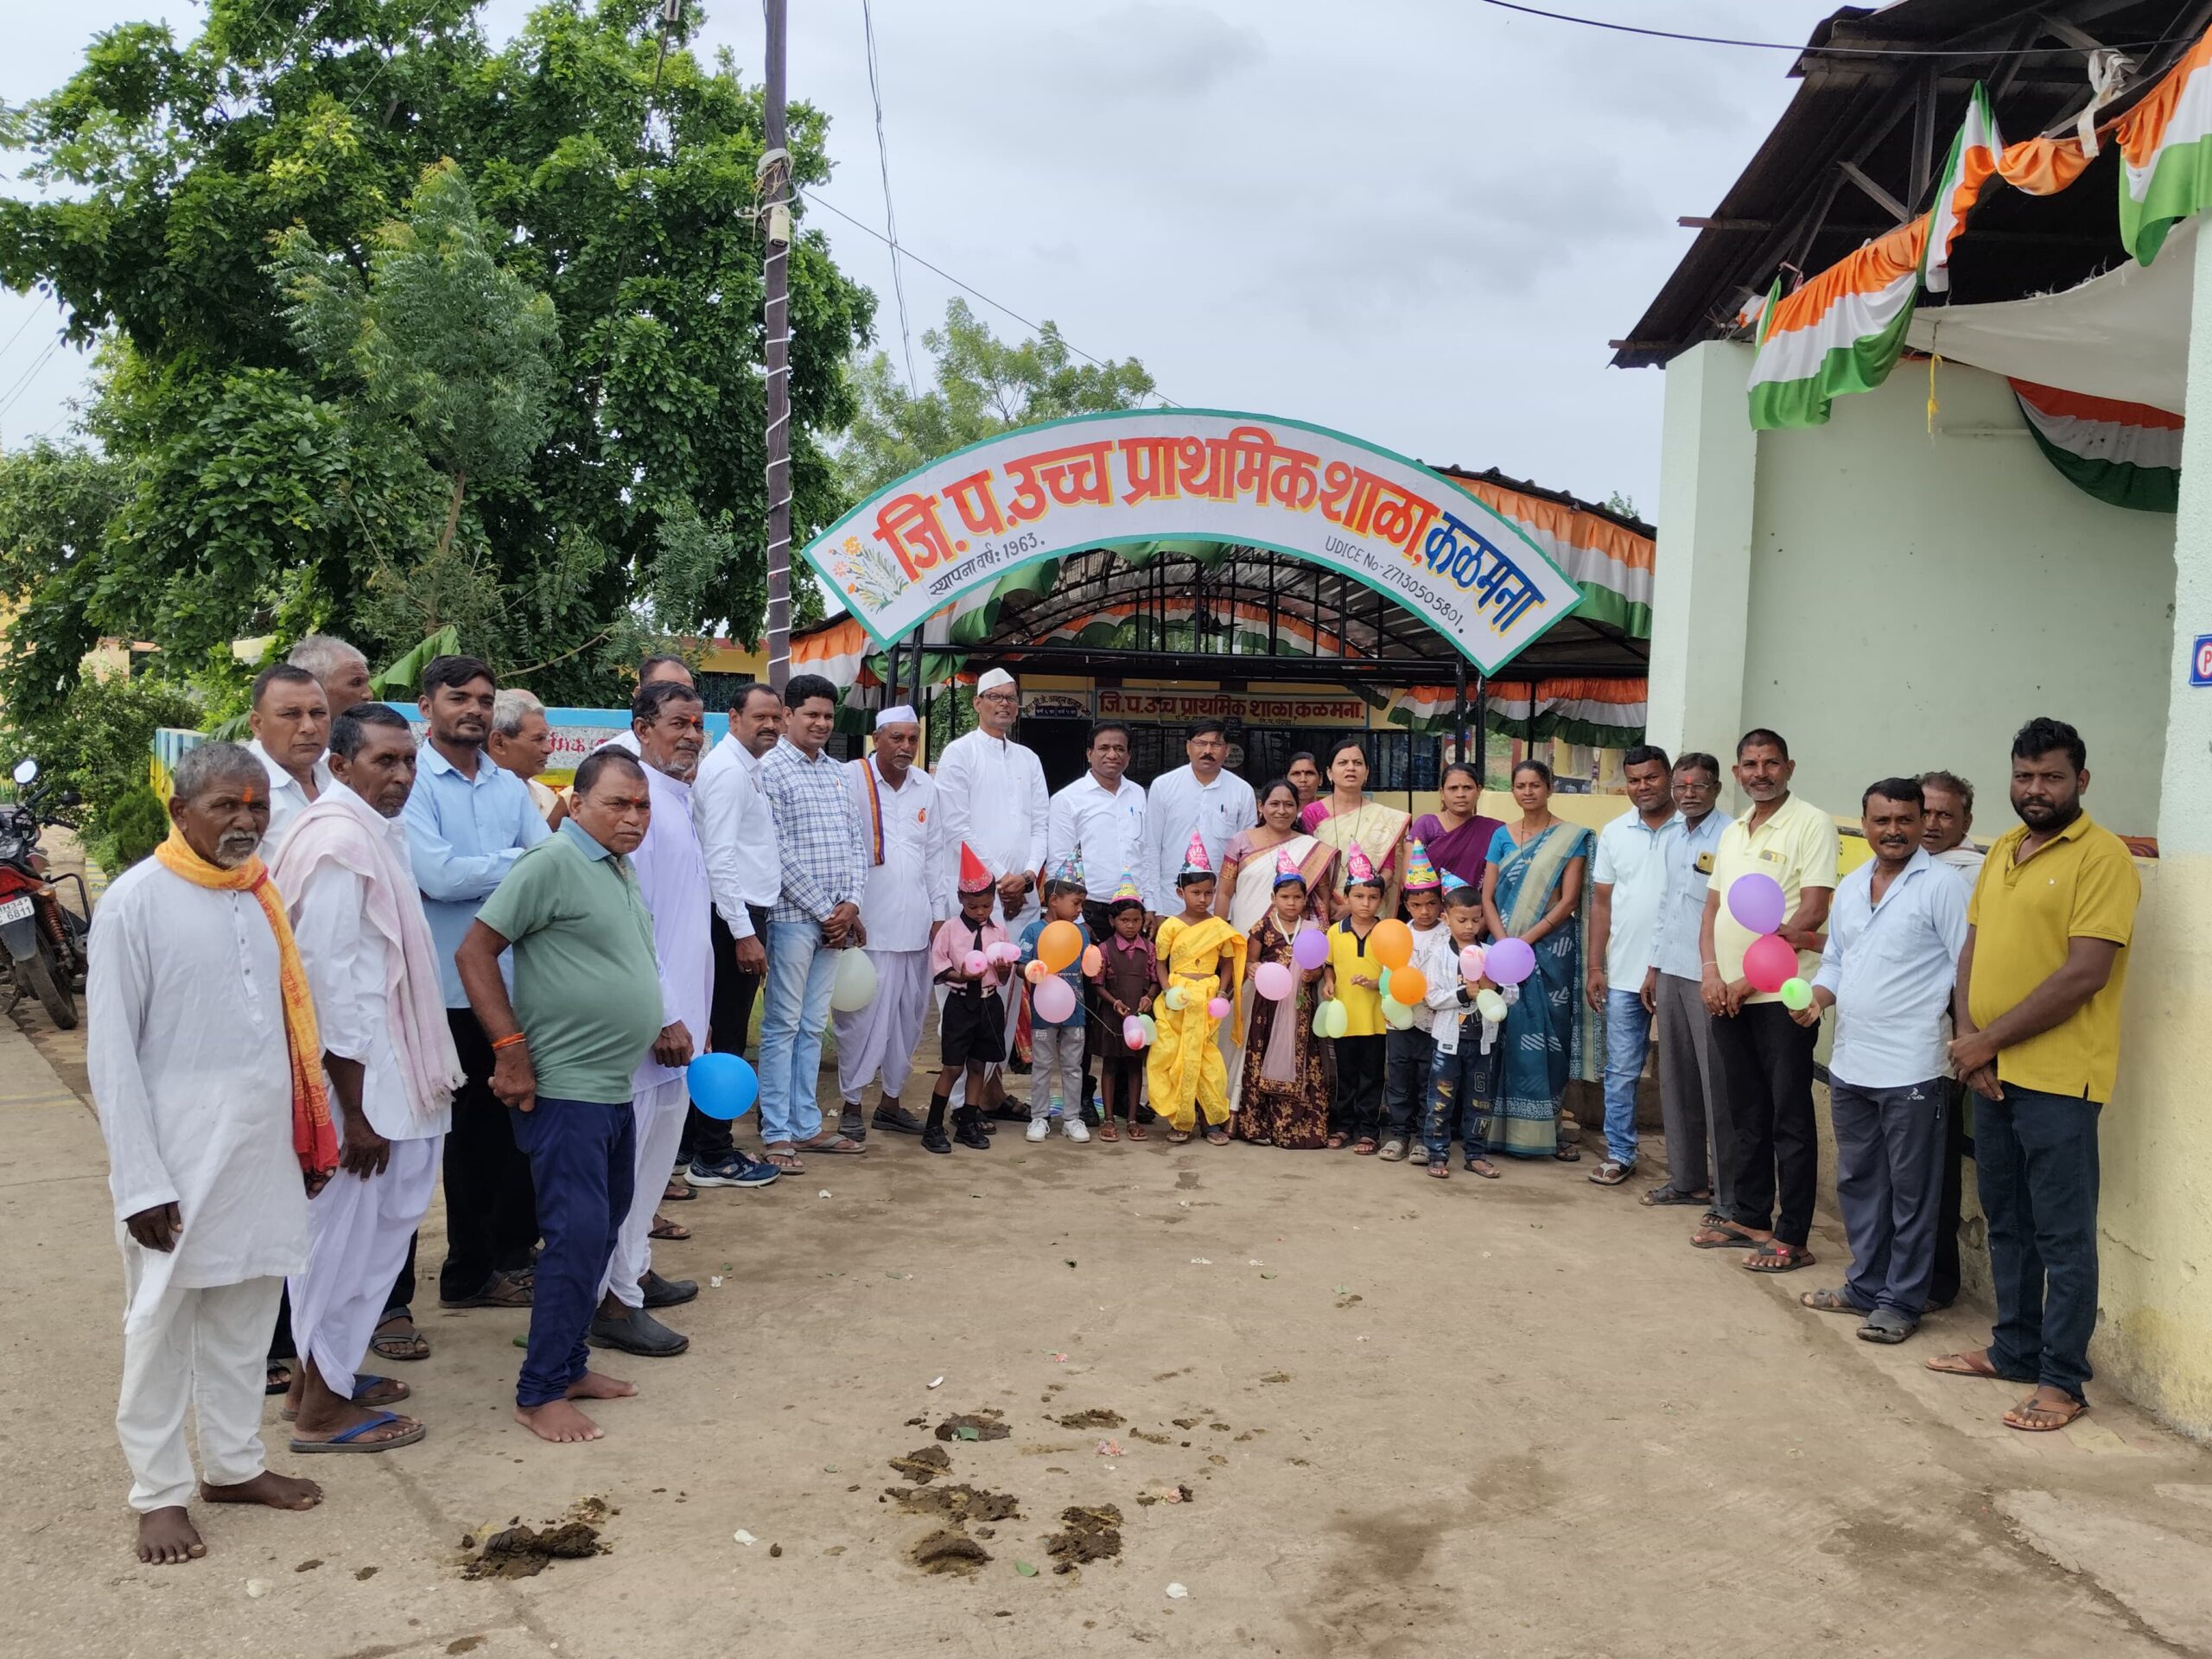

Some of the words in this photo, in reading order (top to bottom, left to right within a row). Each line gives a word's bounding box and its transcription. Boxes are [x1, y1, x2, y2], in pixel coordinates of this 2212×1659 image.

[1118, 426, 1320, 512] प्राथमिक
[1325, 535, 1365, 563] UDICE
[1179, 694, 1247, 716] प्राथमिक
[7, 906, 32, 920] 6811
